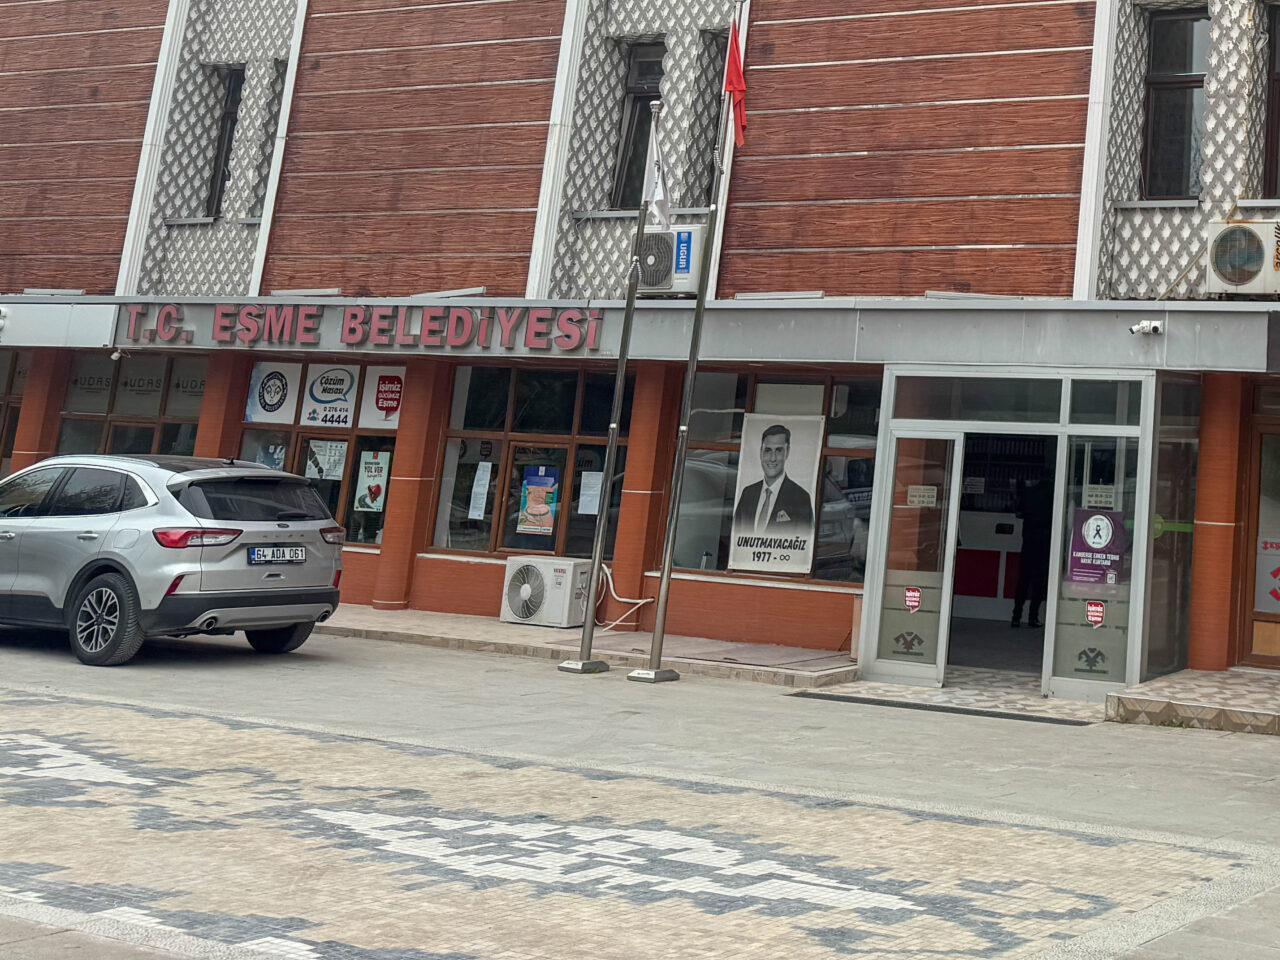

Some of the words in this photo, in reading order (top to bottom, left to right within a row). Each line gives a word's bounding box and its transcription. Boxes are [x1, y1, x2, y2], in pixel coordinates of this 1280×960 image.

[126, 304, 190, 342] T.C.
[212, 304, 320, 346] EŞME
[341, 305, 601, 350] BELEDİYESİ
[320, 376, 345, 386] Çözüm
[321, 386, 344, 395] Masası
[378, 399, 398, 408] Eşme
[321, 413, 348, 425] 4444
[736, 536, 807, 551] UNUTMAYACAĞIZ
[256, 548, 267, 560] 64
[289, 548, 304, 559] 061
[752, 551, 772, 562] 1977
